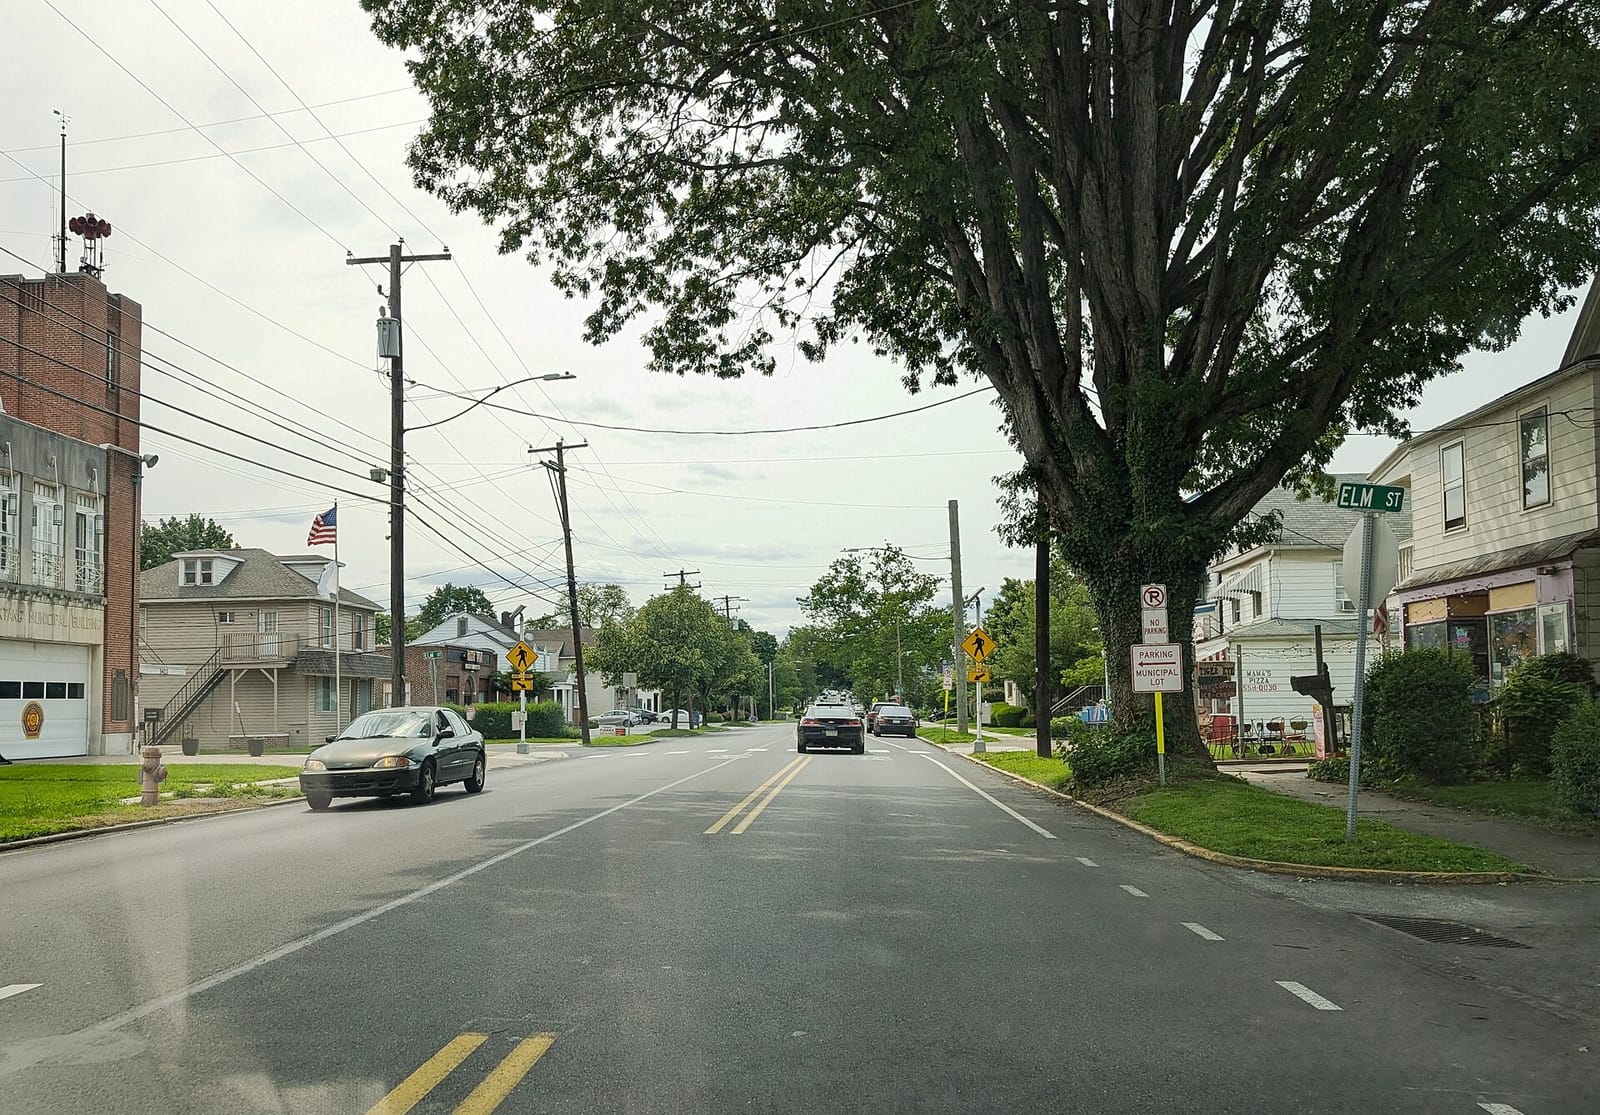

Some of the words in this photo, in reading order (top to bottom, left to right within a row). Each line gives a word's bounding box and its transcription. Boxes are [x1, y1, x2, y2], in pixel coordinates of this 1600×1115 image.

[1340, 486, 1374, 507] ELM
[1386, 492, 1402, 507] ST
[30, 611, 68, 628] MUNICIPAL
[72, 615, 103, 631] BUILDING
[1150, 619, 1160, 627] NO
[1144, 627, 1167, 635] PARKING
[1139, 651, 1173, 659] PARKING
[1136, 668, 1178, 677] MUNICIPAL
[1150, 678, 1165, 686] LOT
